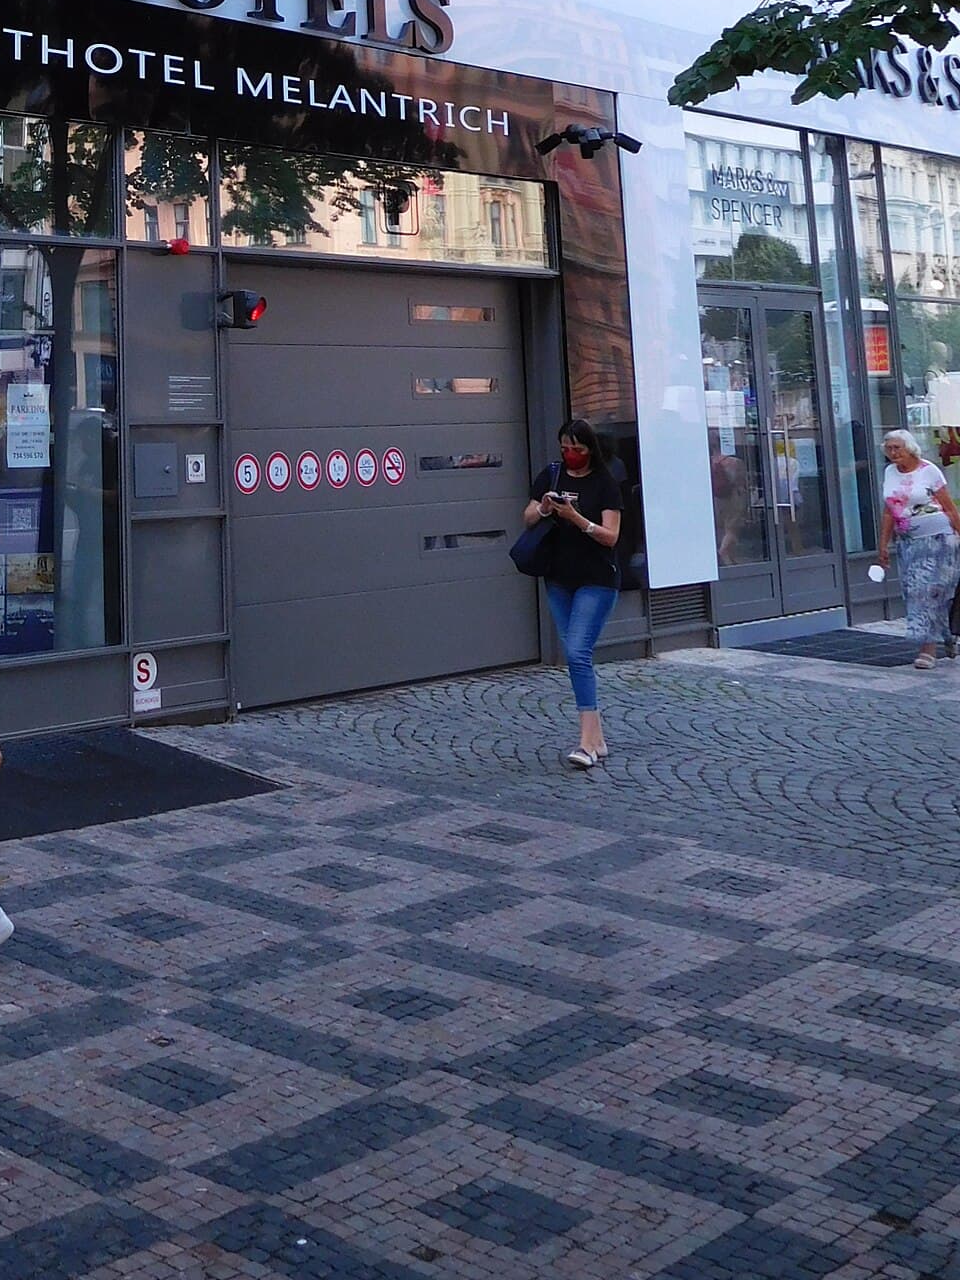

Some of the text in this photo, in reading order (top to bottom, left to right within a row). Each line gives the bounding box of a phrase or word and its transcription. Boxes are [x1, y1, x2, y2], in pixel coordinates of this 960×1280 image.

[237, 67, 510, 137] MELANTRICH
[711, 163, 764, 192] MARKS
[711, 197, 783, 228] SPENCER
[10, 404, 45, 414] PARKING
[244, 465, 252, 483] 5
[136, 658, 151, 683] S
